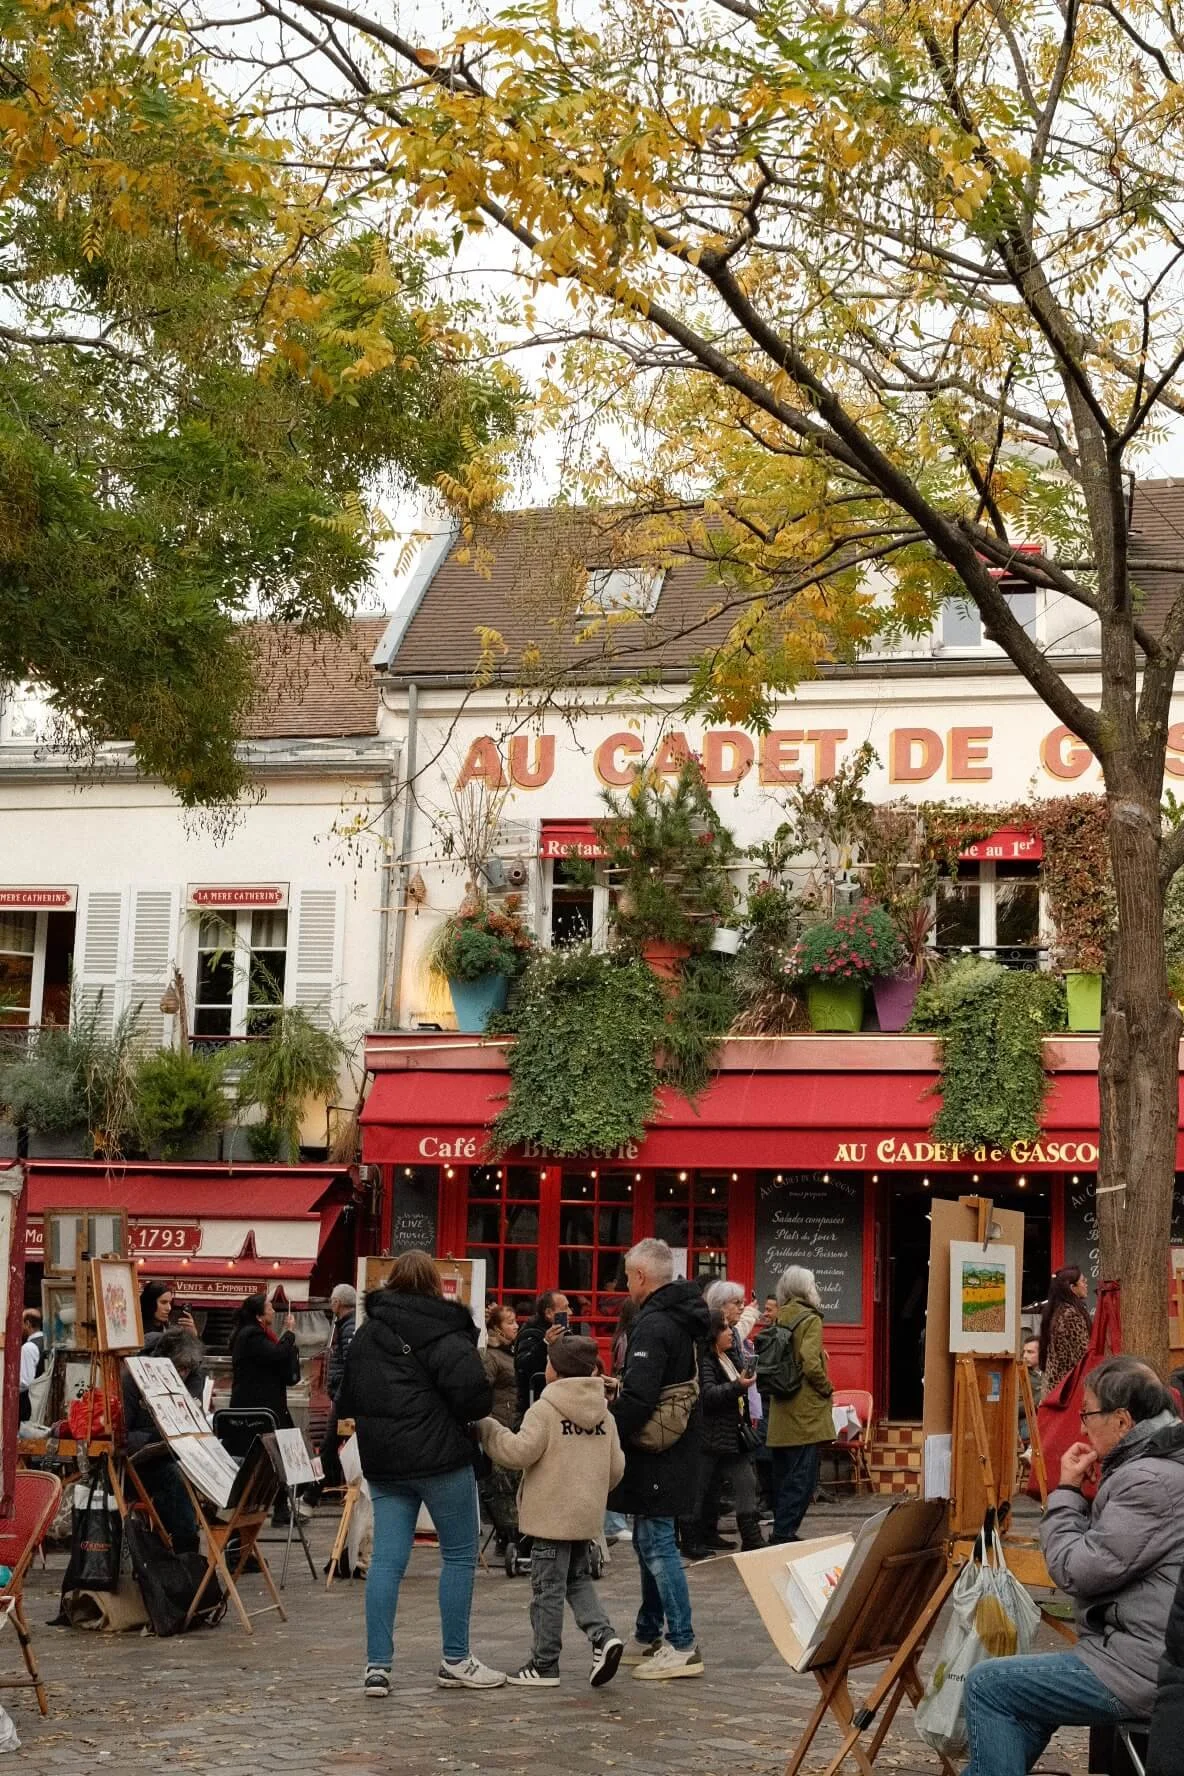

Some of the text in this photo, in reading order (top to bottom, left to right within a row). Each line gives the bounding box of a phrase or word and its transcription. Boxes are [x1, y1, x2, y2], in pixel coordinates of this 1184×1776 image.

[453, 734, 556, 791] AU
[594, 728, 848, 789] CADET
[889, 726, 993, 784] DE
[985, 846, 1003, 857] au
[22, 893, 67, 902] CATHERINE
[198, 892, 209, 900] LA
[234, 892, 280, 900] CATHERINE
[419, 1136, 476, 1158] Café
[834, 1137, 1099, 1164] AU CADET de GASCO
[772, 1210, 804, 1223] Salades
[402, 1220, 424, 1228] LIVE
[139, 1229, 186, 1248] 1793
[399, 1231, 430, 1239] MUSIC
[775, 1228, 799, 1240] Plats
[765, 1246, 806, 1263] Grillades
[813, 1247, 849, 1258] Poissons
[815, 1267, 845, 1275] maison
